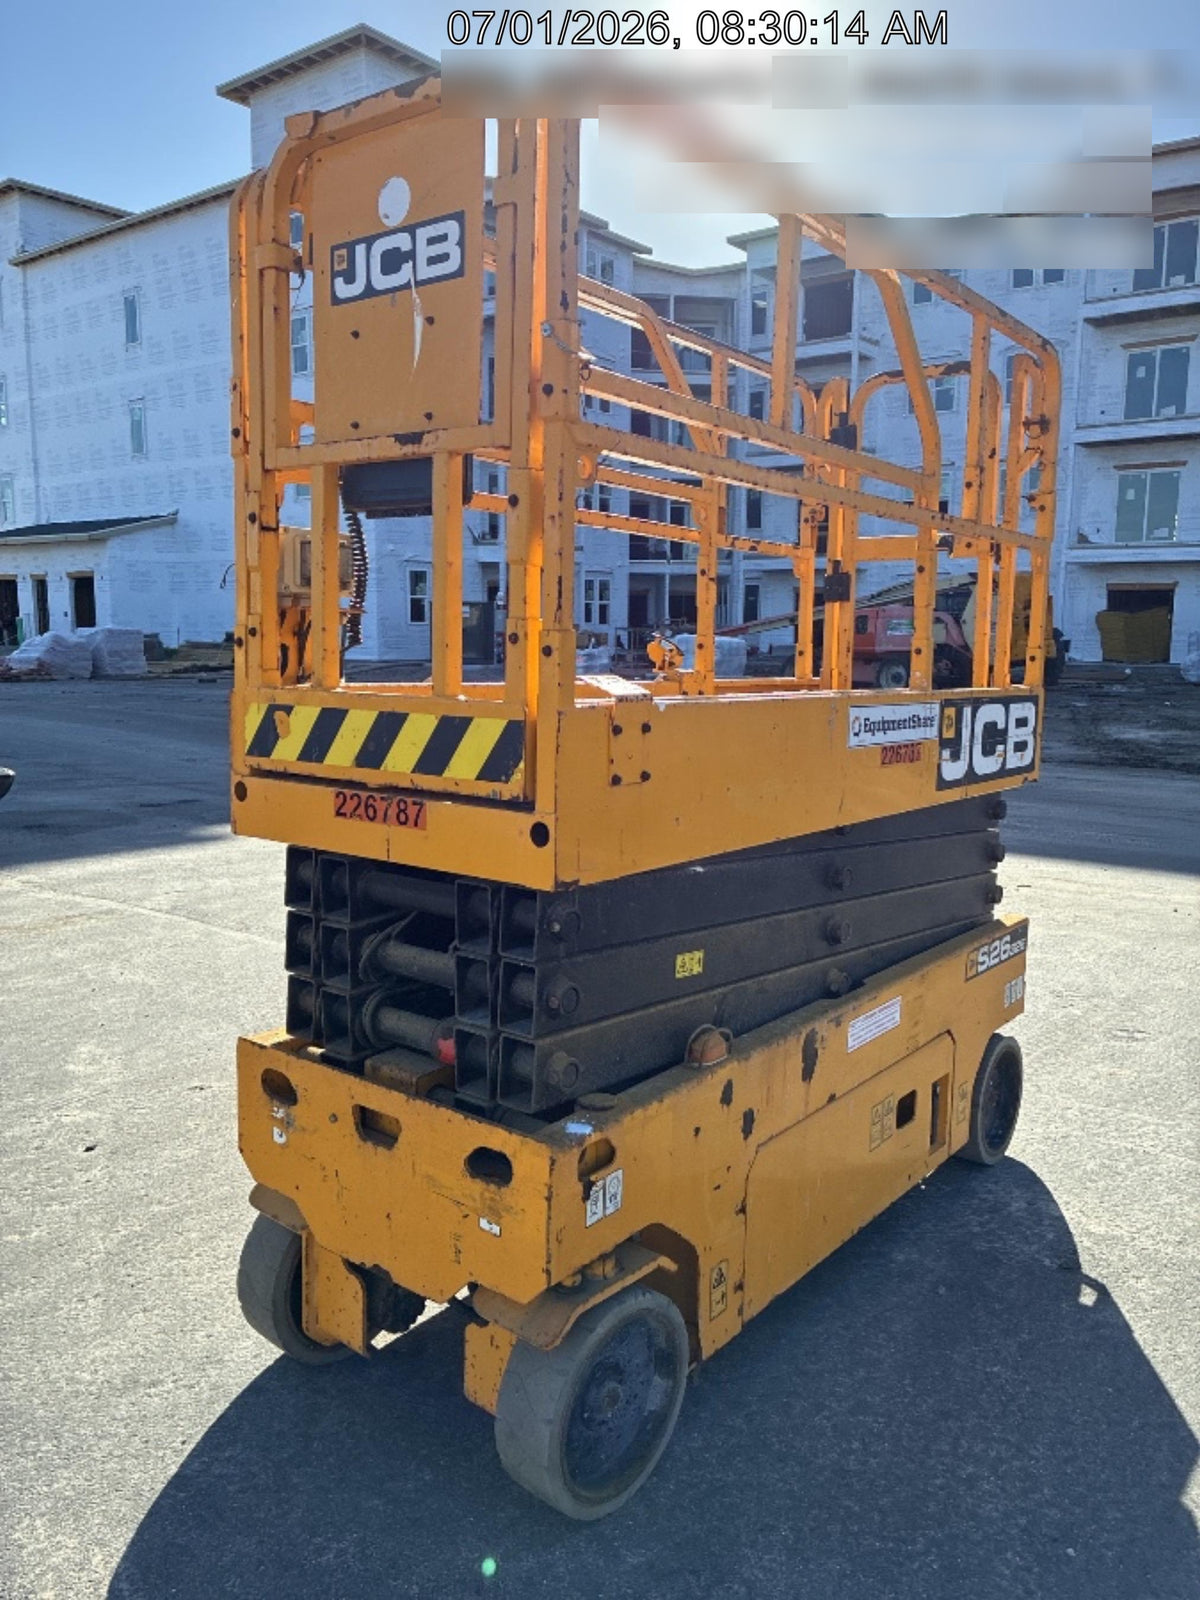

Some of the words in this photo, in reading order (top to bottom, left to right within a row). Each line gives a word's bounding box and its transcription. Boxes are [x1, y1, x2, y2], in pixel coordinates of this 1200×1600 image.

[334, 220, 462, 299] JCB
[863, 714, 936, 736] EquipmentShare
[941, 702, 1036, 781] JCB
[335, 791, 424, 827] 226787
